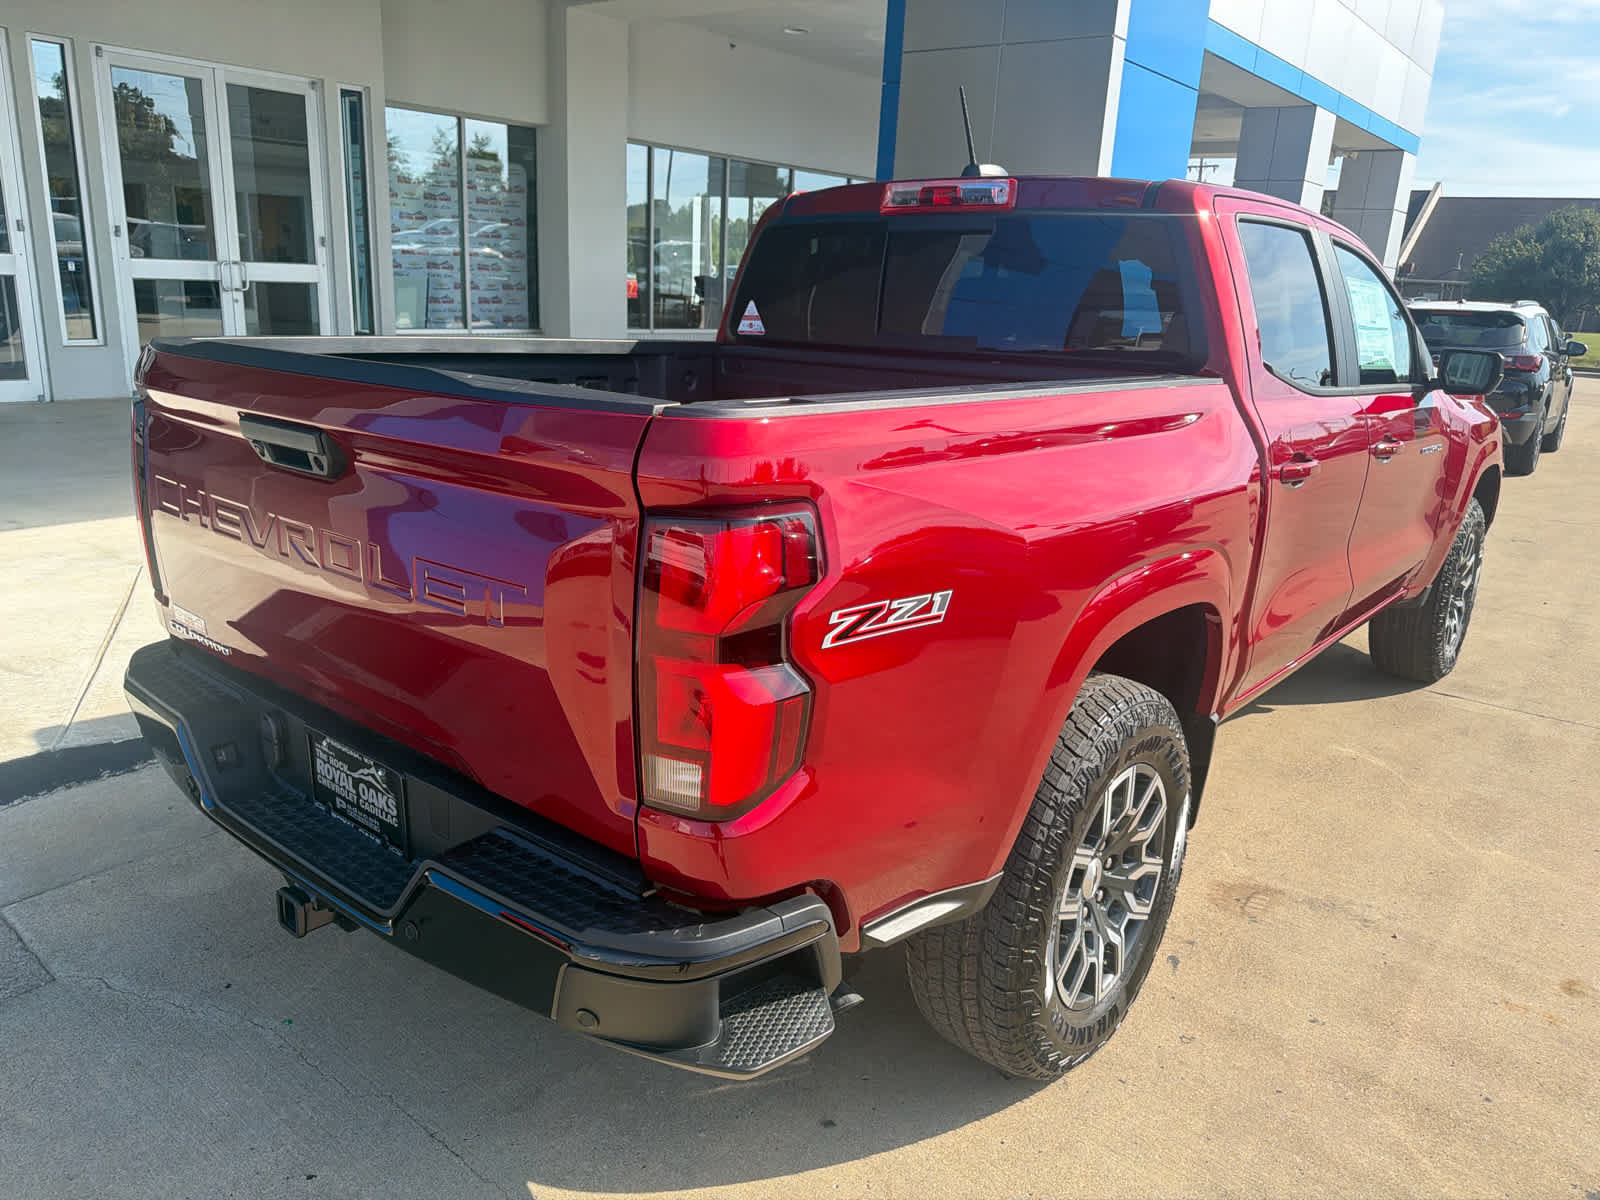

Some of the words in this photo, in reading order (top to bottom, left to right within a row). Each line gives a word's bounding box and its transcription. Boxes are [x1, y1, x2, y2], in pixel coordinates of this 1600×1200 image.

[155, 475, 527, 627] CHEVROLET
[821, 589, 953, 650] Z71
[316, 758, 357, 794] ROYAL
[358, 783, 398, 817] OAKS
[317, 774, 357, 804] CHEVROLET
[359, 799, 399, 828] CADILLAC
